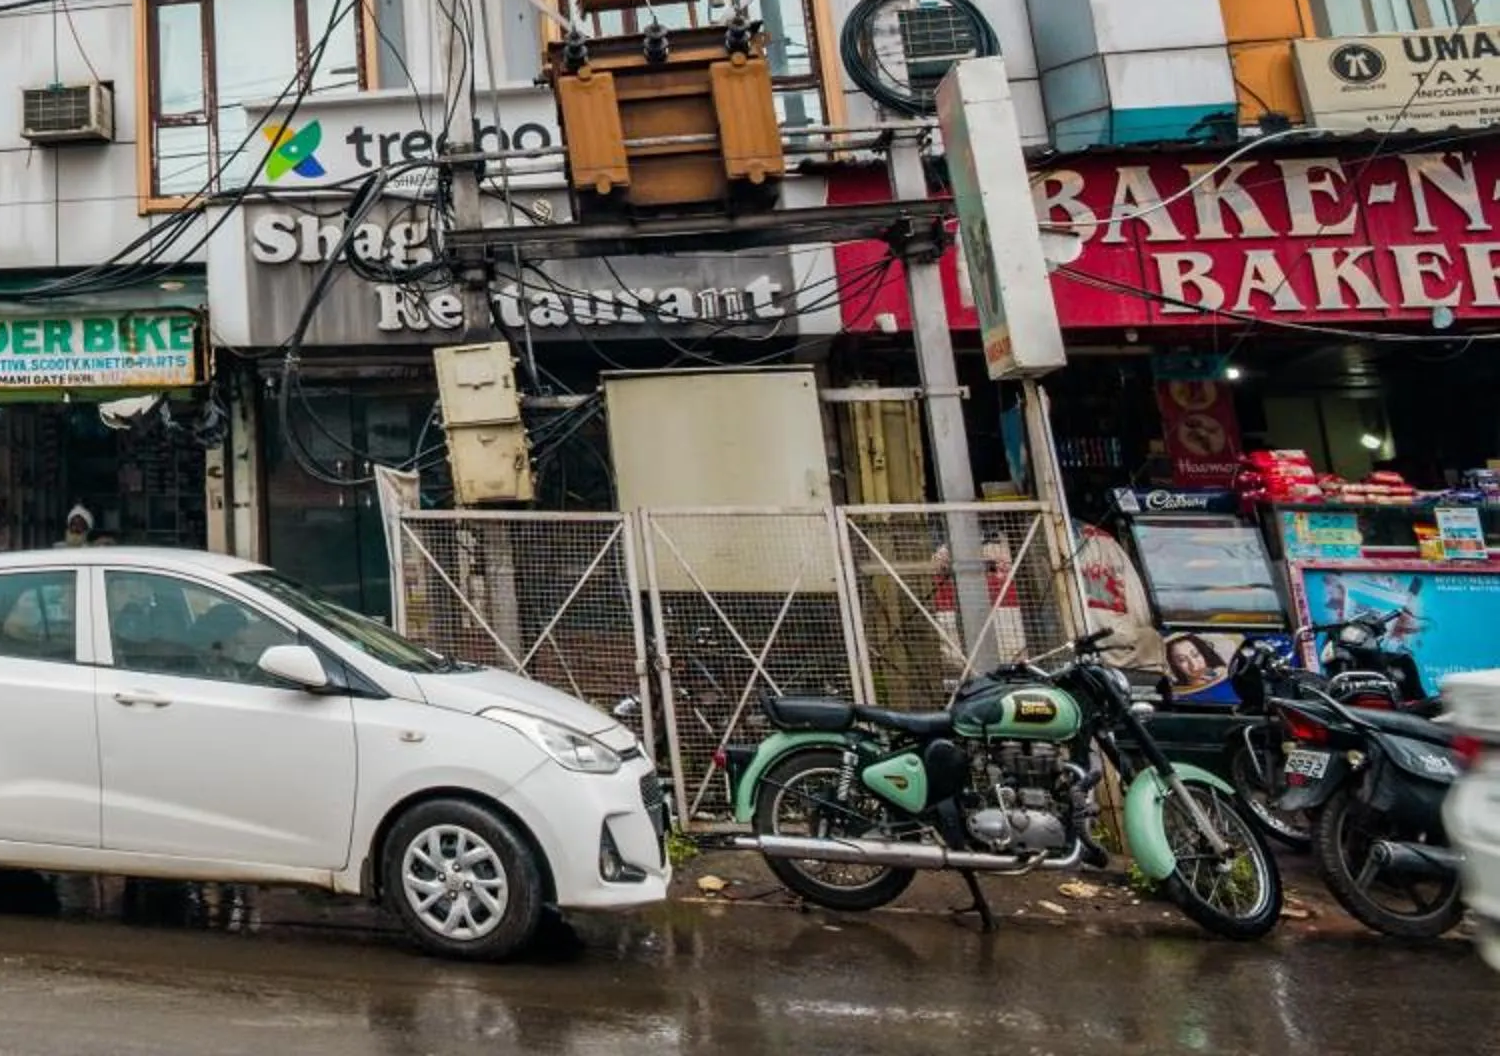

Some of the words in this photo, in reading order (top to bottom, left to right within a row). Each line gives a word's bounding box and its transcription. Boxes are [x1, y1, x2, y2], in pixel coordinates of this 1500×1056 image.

[1029, 151, 1500, 244] BAKE-N
[253, 213, 436, 270] Shag
[375, 275, 785, 332] Retaurant
[83, 315, 194, 352] BIKE
[1146, 489, 1208, 510] Cadbury
